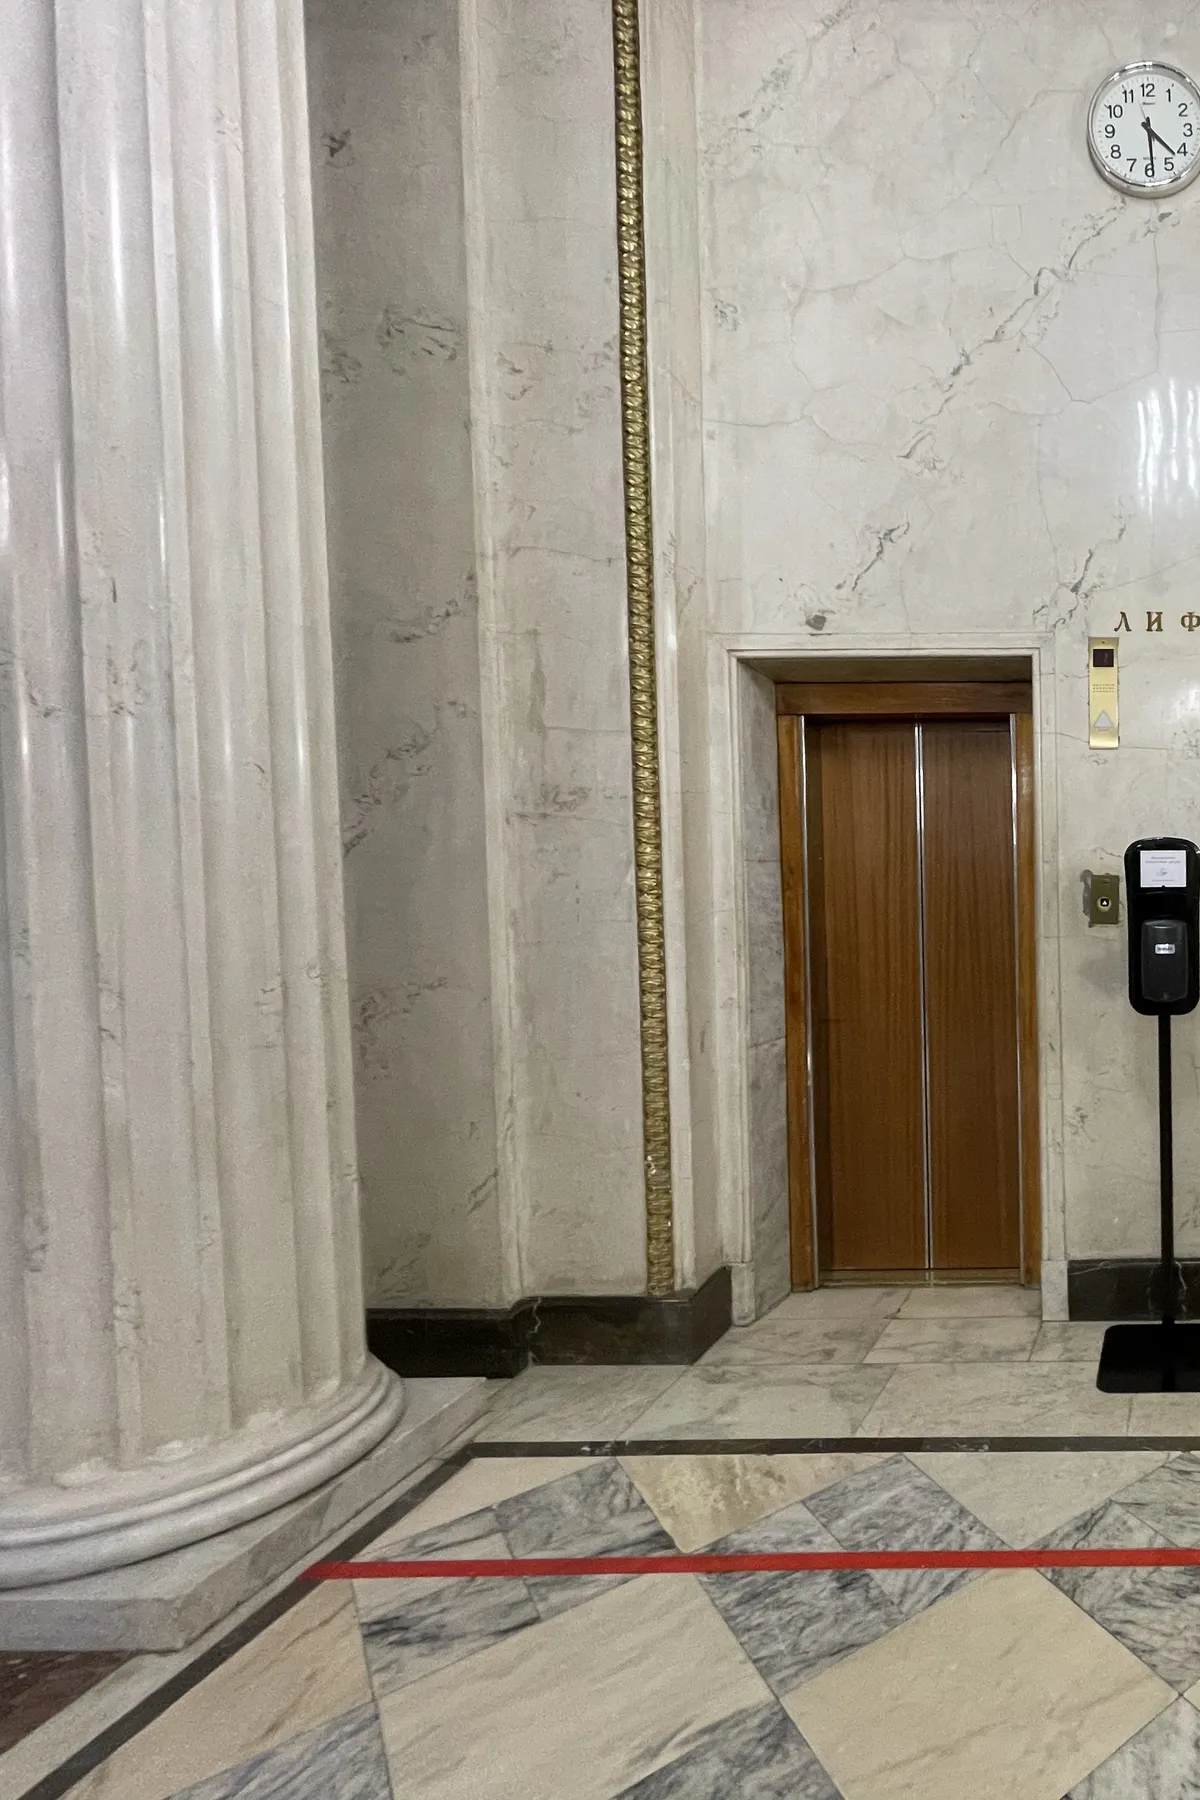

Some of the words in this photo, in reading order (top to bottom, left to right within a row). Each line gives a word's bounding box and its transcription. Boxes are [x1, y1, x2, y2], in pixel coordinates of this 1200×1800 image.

[1122, 89, 1134, 103] 11
[1140, 83, 1155, 97] 12
[1166, 88, 1171, 102] 1
[1108, 104, 1123, 118] 10
[1178, 103, 1188, 117] 2
[1104, 124, 1115, 138] 9
[1183, 123, 1193, 137] 3
[1110, 144, 1121, 159] 8
[1177, 143, 1188, 156] 4
[1126, 158, 1137, 172] 7
[1144, 163, 1155, 178] 6
[1164, 157, 1174, 171] 5
